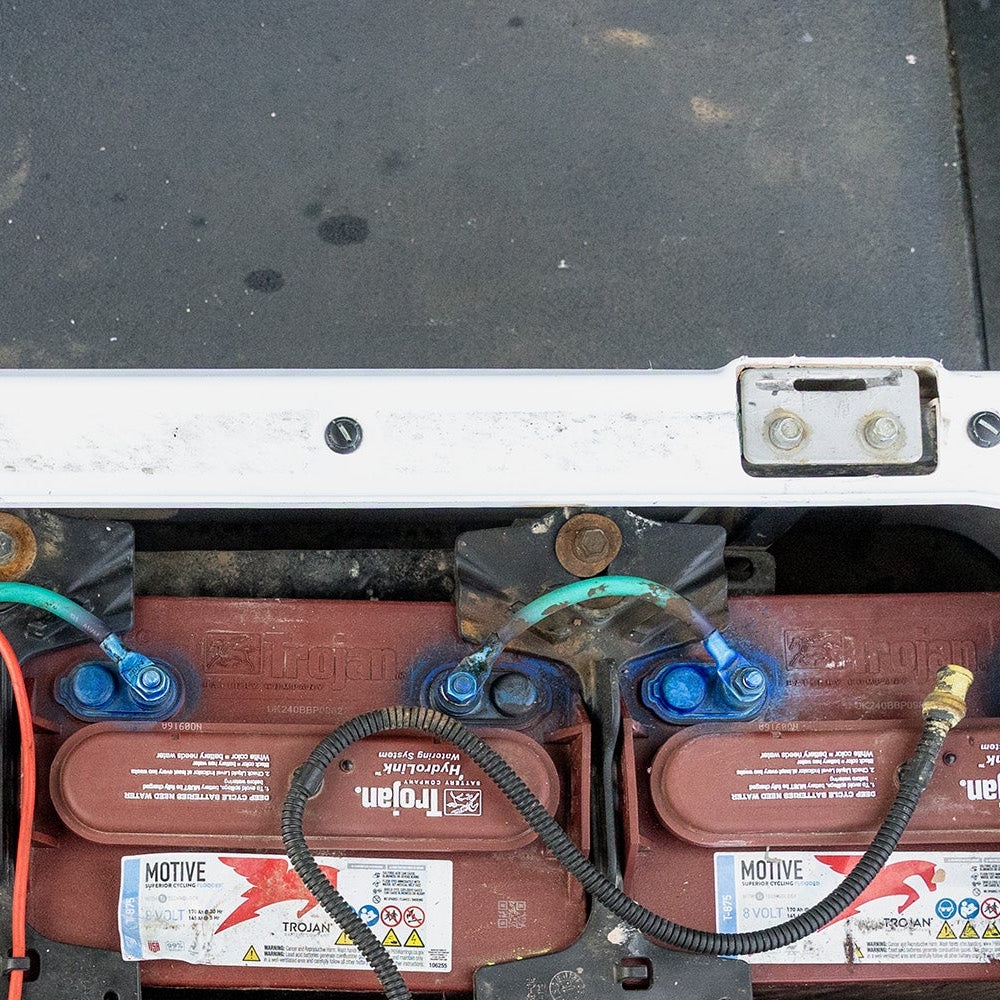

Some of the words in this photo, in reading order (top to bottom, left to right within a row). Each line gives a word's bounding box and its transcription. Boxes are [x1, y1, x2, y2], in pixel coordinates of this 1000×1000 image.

[379, 751, 414, 760] System
[418, 751, 460, 761] Watering
[145, 862, 206, 882] MOTIVE
[741, 860, 803, 880] MOTIVE
[743, 908, 750, 919] 8
[753, 908, 783, 918] VOLT
[283, 922, 330, 933] TROJAN
